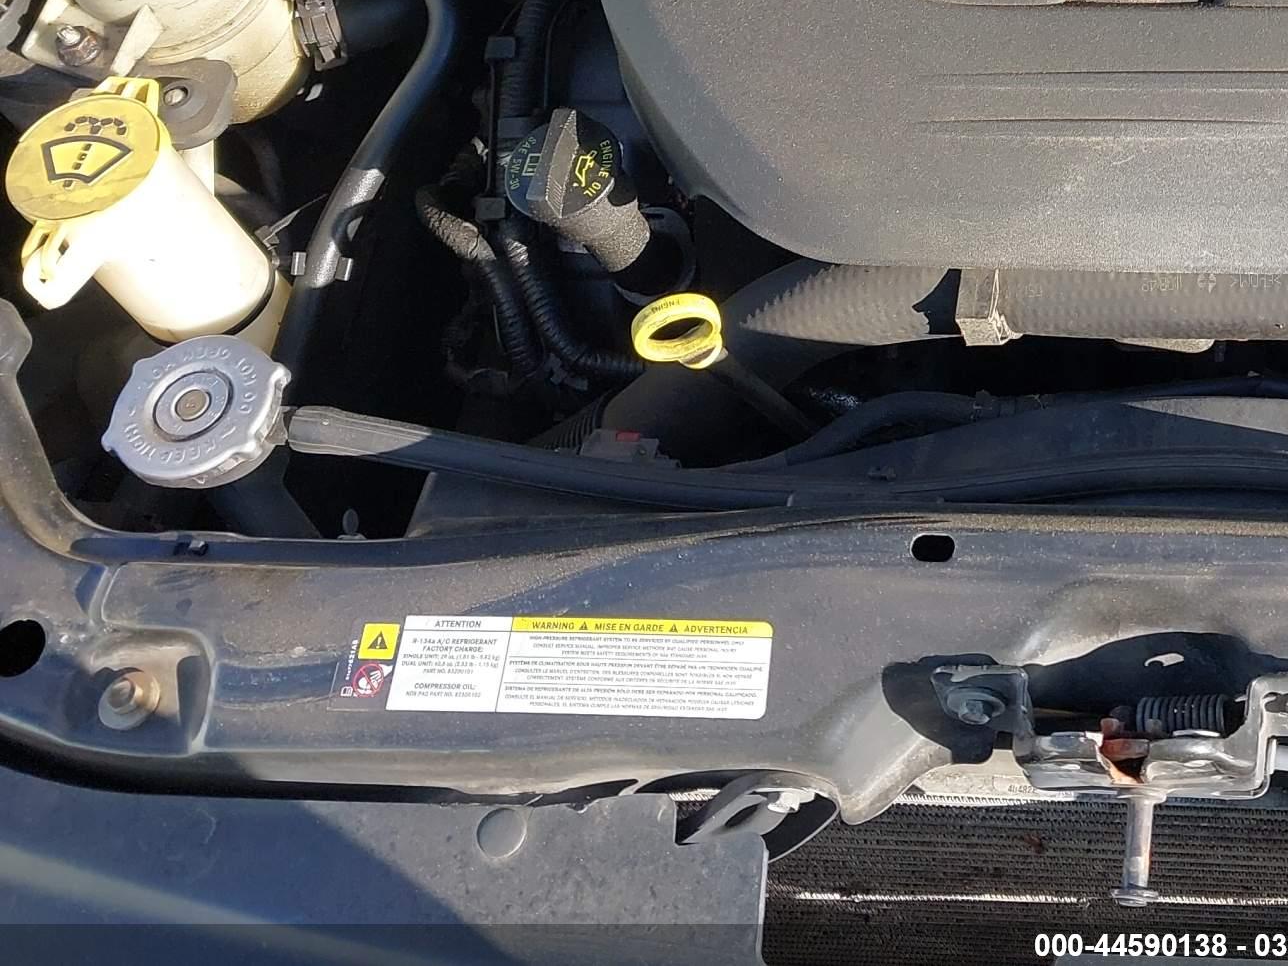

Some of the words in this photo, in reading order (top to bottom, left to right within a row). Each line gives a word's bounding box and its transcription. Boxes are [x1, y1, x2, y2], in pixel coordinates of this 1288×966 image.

[518, 136, 536, 155] SAE
[598, 139, 613, 179] ENGINE
[510, 158, 522, 191] 5W-30
[583, 181, 602, 197] OIL
[434, 620, 482, 628] ATTENTION
[532, 621, 574, 630] WARNING
[594, 623, 617, 631] MISE
[619, 623, 631, 631] EN
[633, 624, 664, 632] GARDE
[683, 625, 748, 634] ADVERTENCIA
[414, 682, 461, 690] COMPRESSOR
